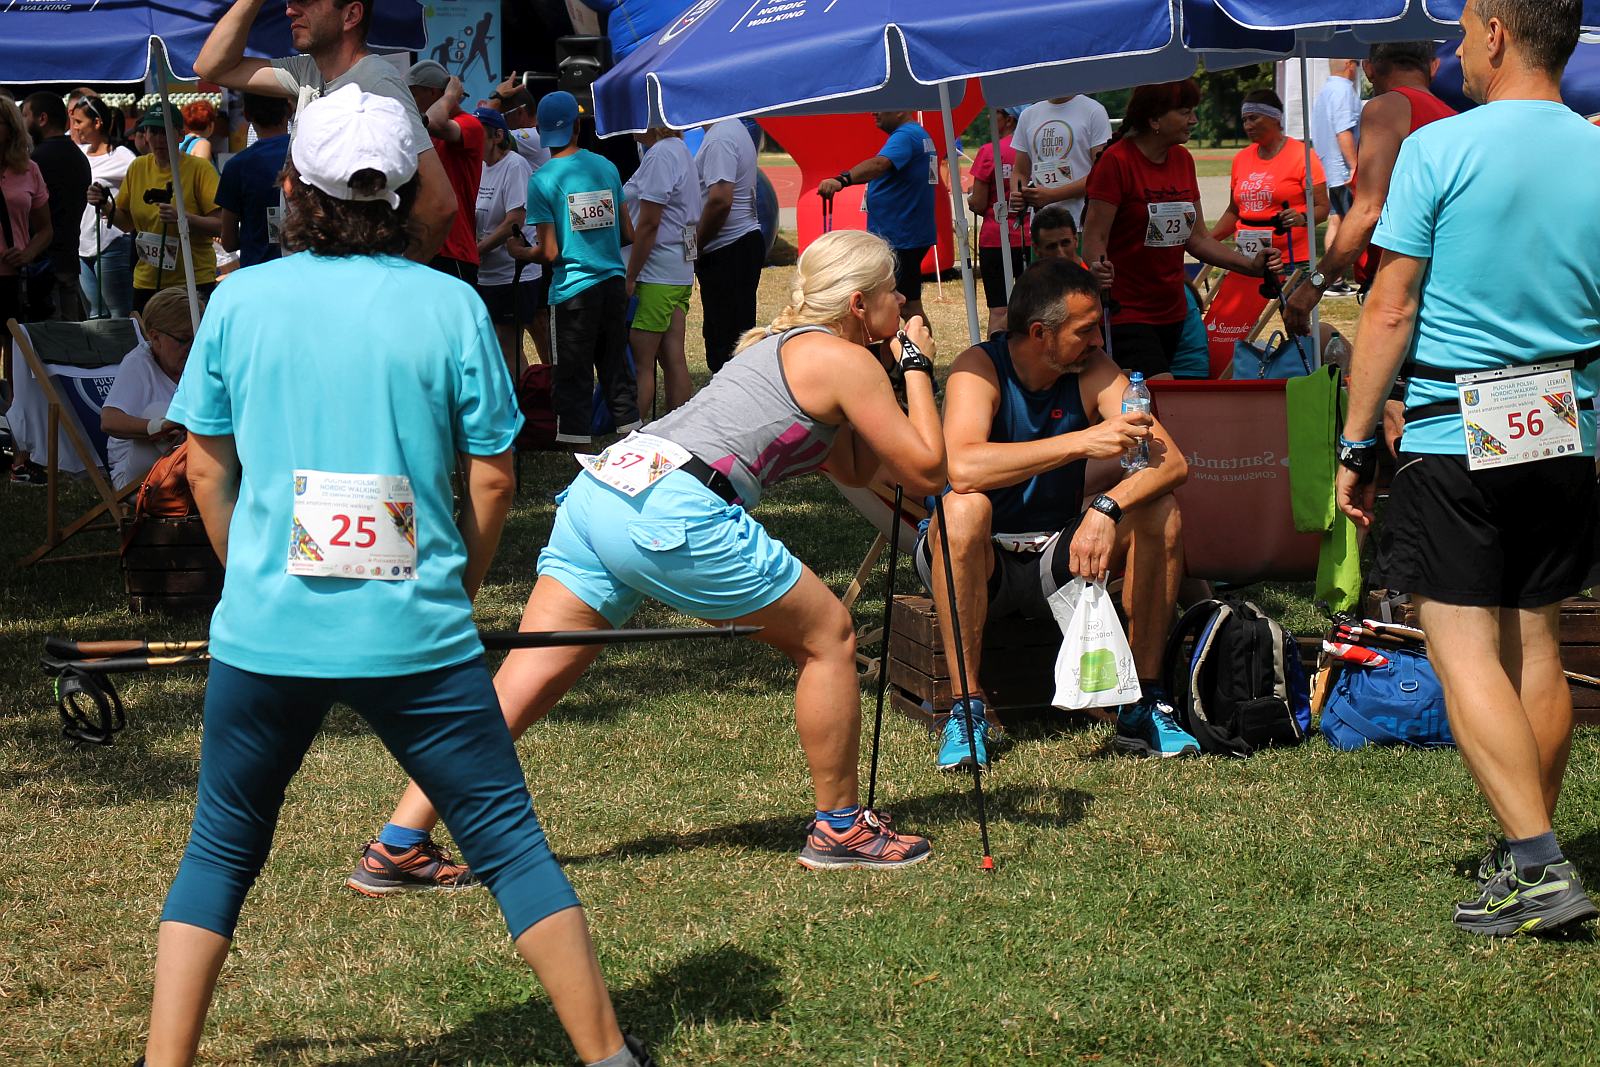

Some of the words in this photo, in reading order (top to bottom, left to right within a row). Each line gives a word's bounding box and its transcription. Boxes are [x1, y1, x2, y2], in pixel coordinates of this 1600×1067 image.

[757, 0, 807, 16] NORDIC
[747, 10, 806, 28] WALKING
[1043, 128, 1056, 137] THE
[1041, 136, 1064, 147] COLOR
[1044, 172, 1058, 184] 31
[581, 205, 604, 219] 186
[1165, 219, 1181, 234] 23
[145, 245, 164, 258] 18
[1245, 241, 1257, 253] 62
[1216, 322, 1251, 334] Santande
[1492, 383, 1516, 391] PUCHAR
[1516, 380, 1535, 389] POLSKI
[1490, 389, 1513, 398] NORDIC
[1513, 386, 1538, 395] WALKING
[1507, 408, 1544, 440] 56
[611, 452, 645, 470] 57
[320, 484, 346, 492] NORDIC
[348, 486, 380, 494] WALKING
[329, 514, 377, 548] 25
